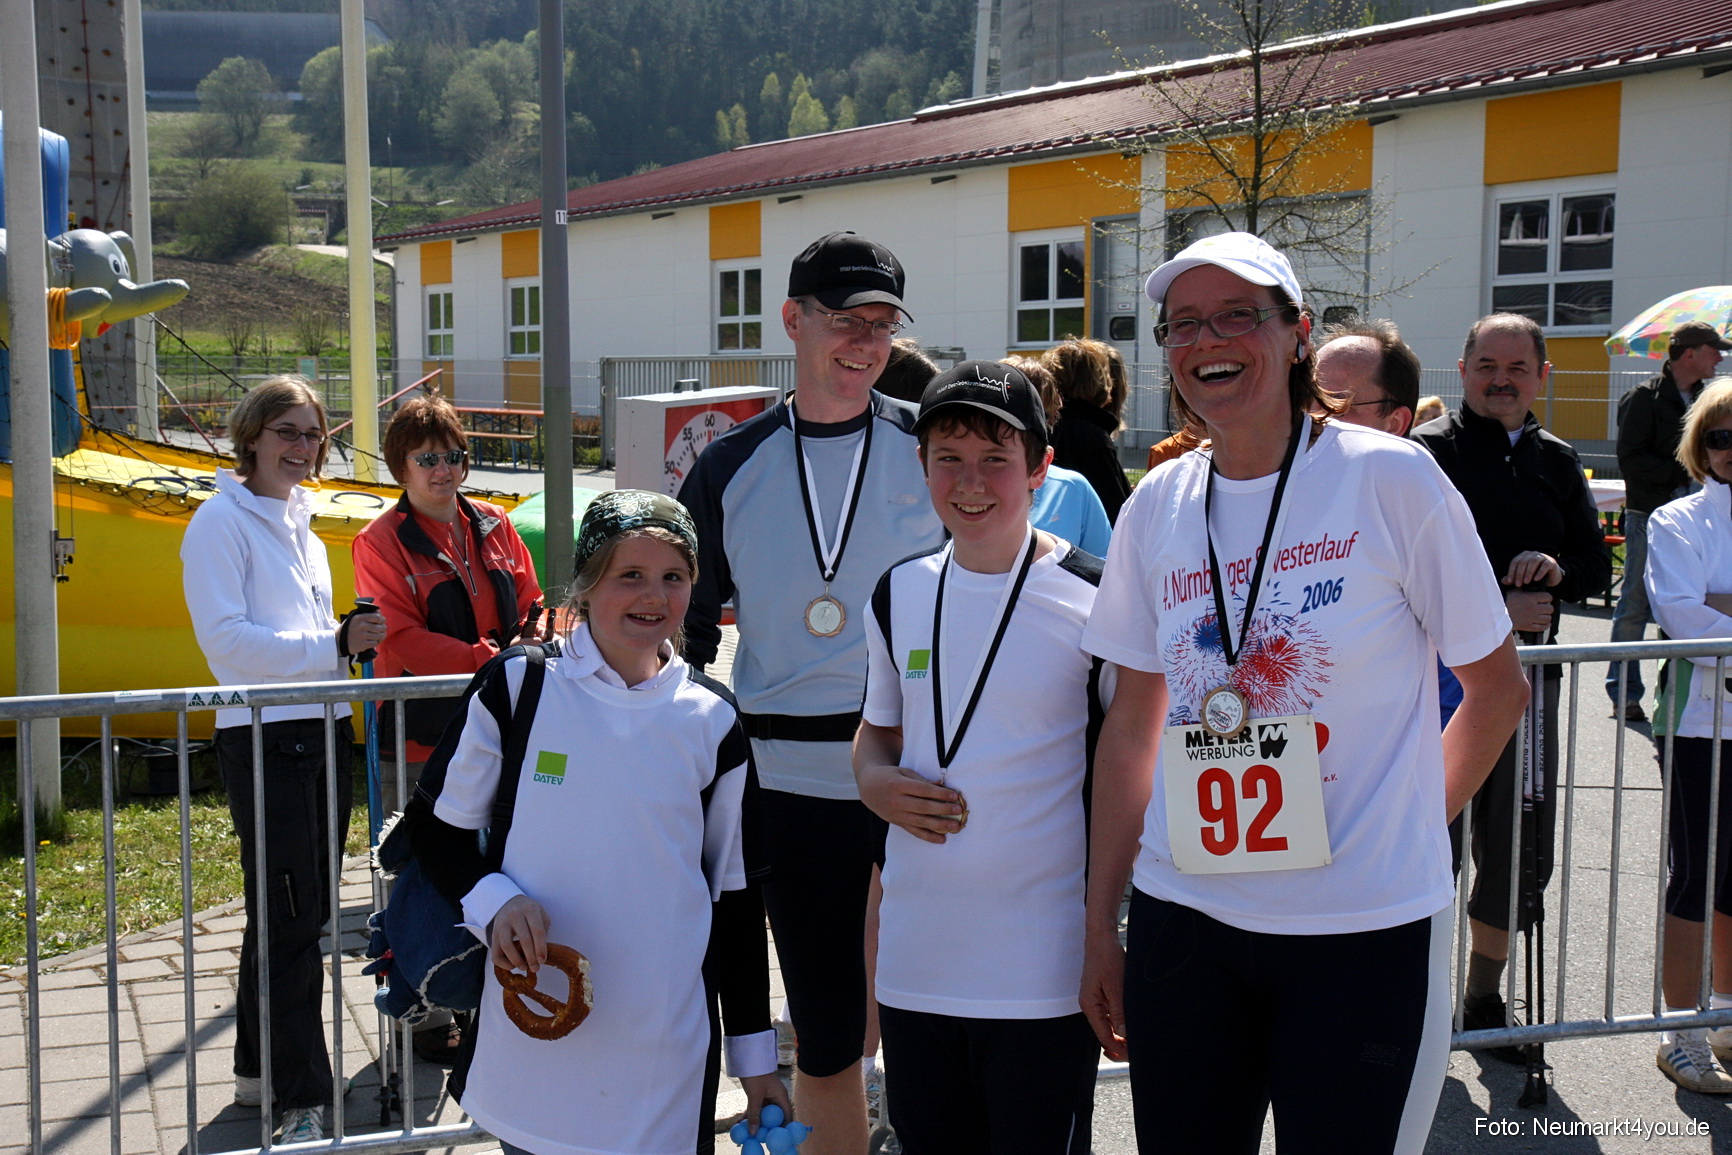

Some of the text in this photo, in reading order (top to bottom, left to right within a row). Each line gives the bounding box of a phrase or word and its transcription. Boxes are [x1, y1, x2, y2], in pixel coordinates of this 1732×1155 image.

[556, 211, 566, 223] 11
[704, 414, 715, 427] 60
[682, 427, 693, 441] 55
[664, 460, 675, 474] 50
[1172, 556, 1252, 608] Nürnbger
[1255, 531, 1360, 574] vesterlauf
[1301, 576, 1345, 614] 2006
[905, 671, 928, 679] DATEV
[1186, 744, 1255, 761] WERBUNG
[533, 773, 564, 786] DATEV
[1323, 773, 1338, 783] e.V.
[1197, 764, 1289, 857] 92
